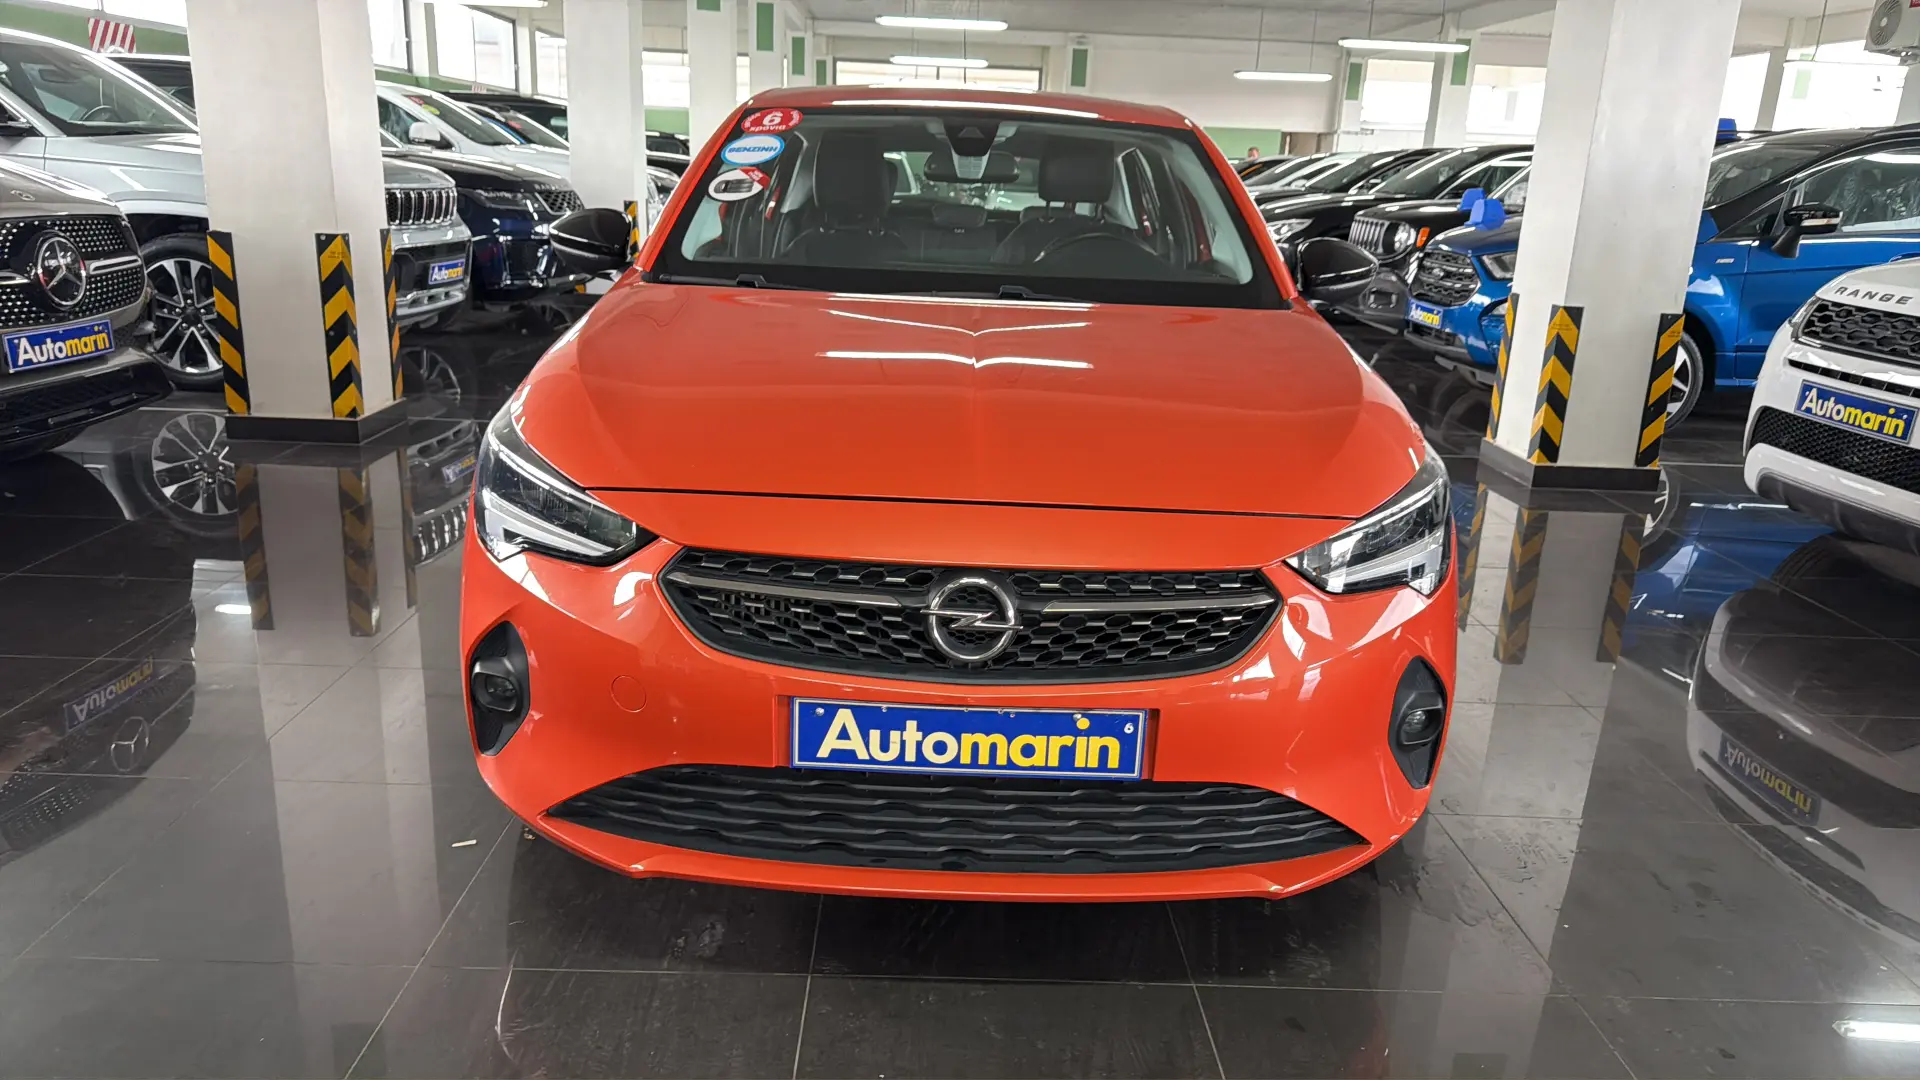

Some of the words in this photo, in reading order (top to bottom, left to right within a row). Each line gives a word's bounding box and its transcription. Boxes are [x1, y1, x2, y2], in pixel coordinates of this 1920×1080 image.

[762, 111, 783, 126] 6
[1834, 286, 1914, 305] RANGE
[17, 325, 110, 366] Automarin
[1801, 388, 1905, 438] Automarin
[816, 708, 1121, 769] Automarin
[1124, 722, 1135, 734] 6
